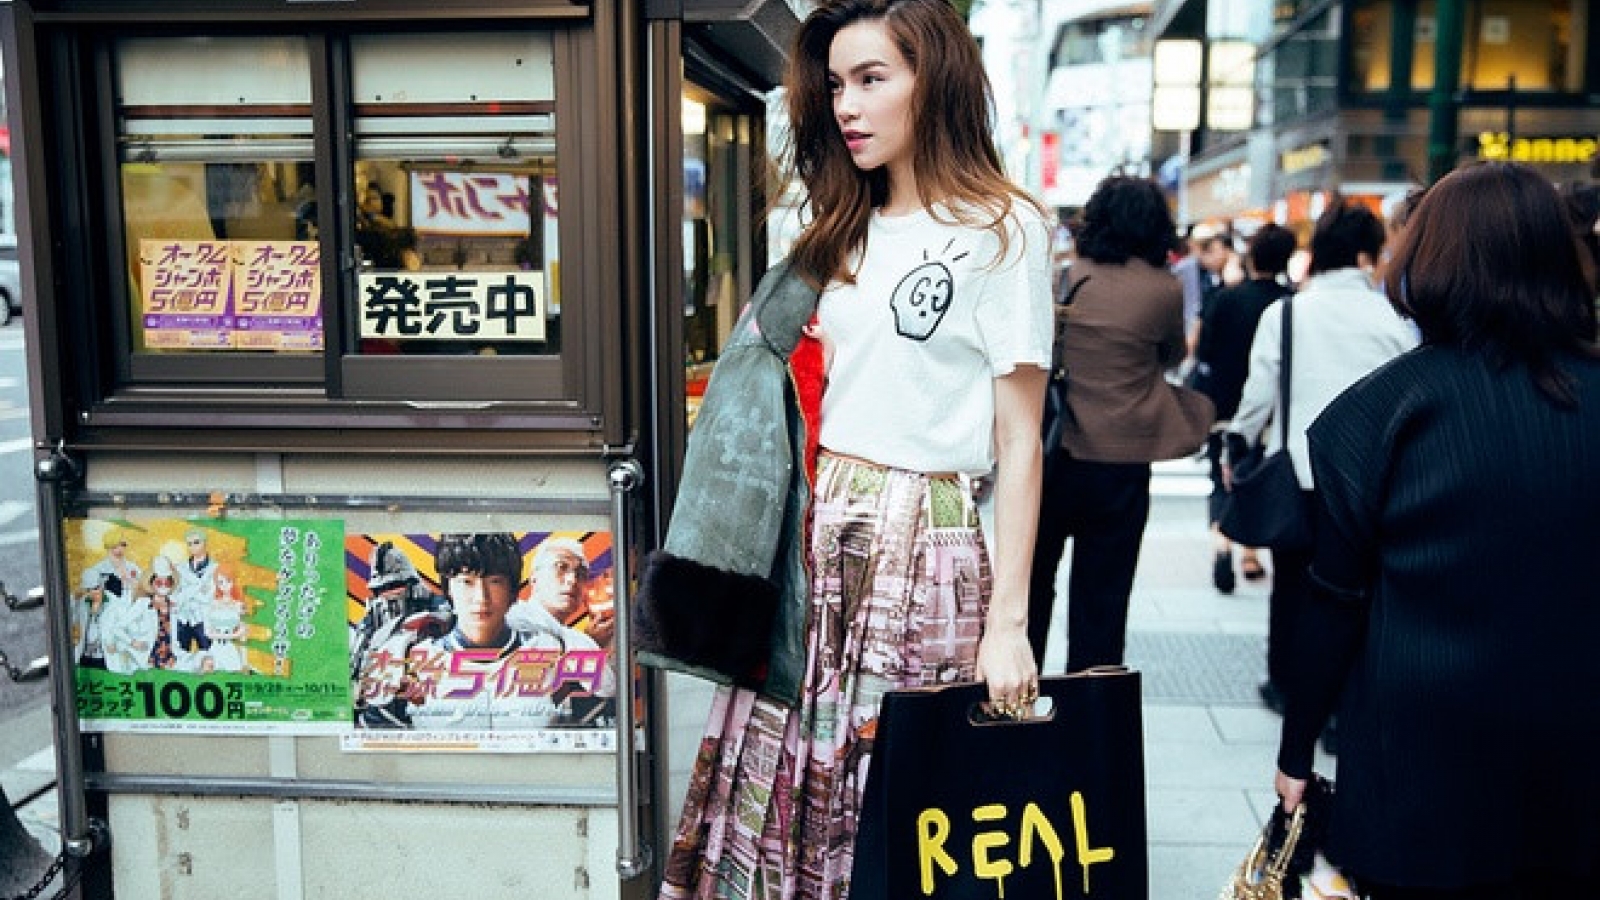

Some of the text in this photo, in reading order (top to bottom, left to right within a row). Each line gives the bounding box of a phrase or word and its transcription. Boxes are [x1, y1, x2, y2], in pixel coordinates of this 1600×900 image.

[365, 274, 535, 335] 発売中
[916, 790, 1115, 897] REAL
